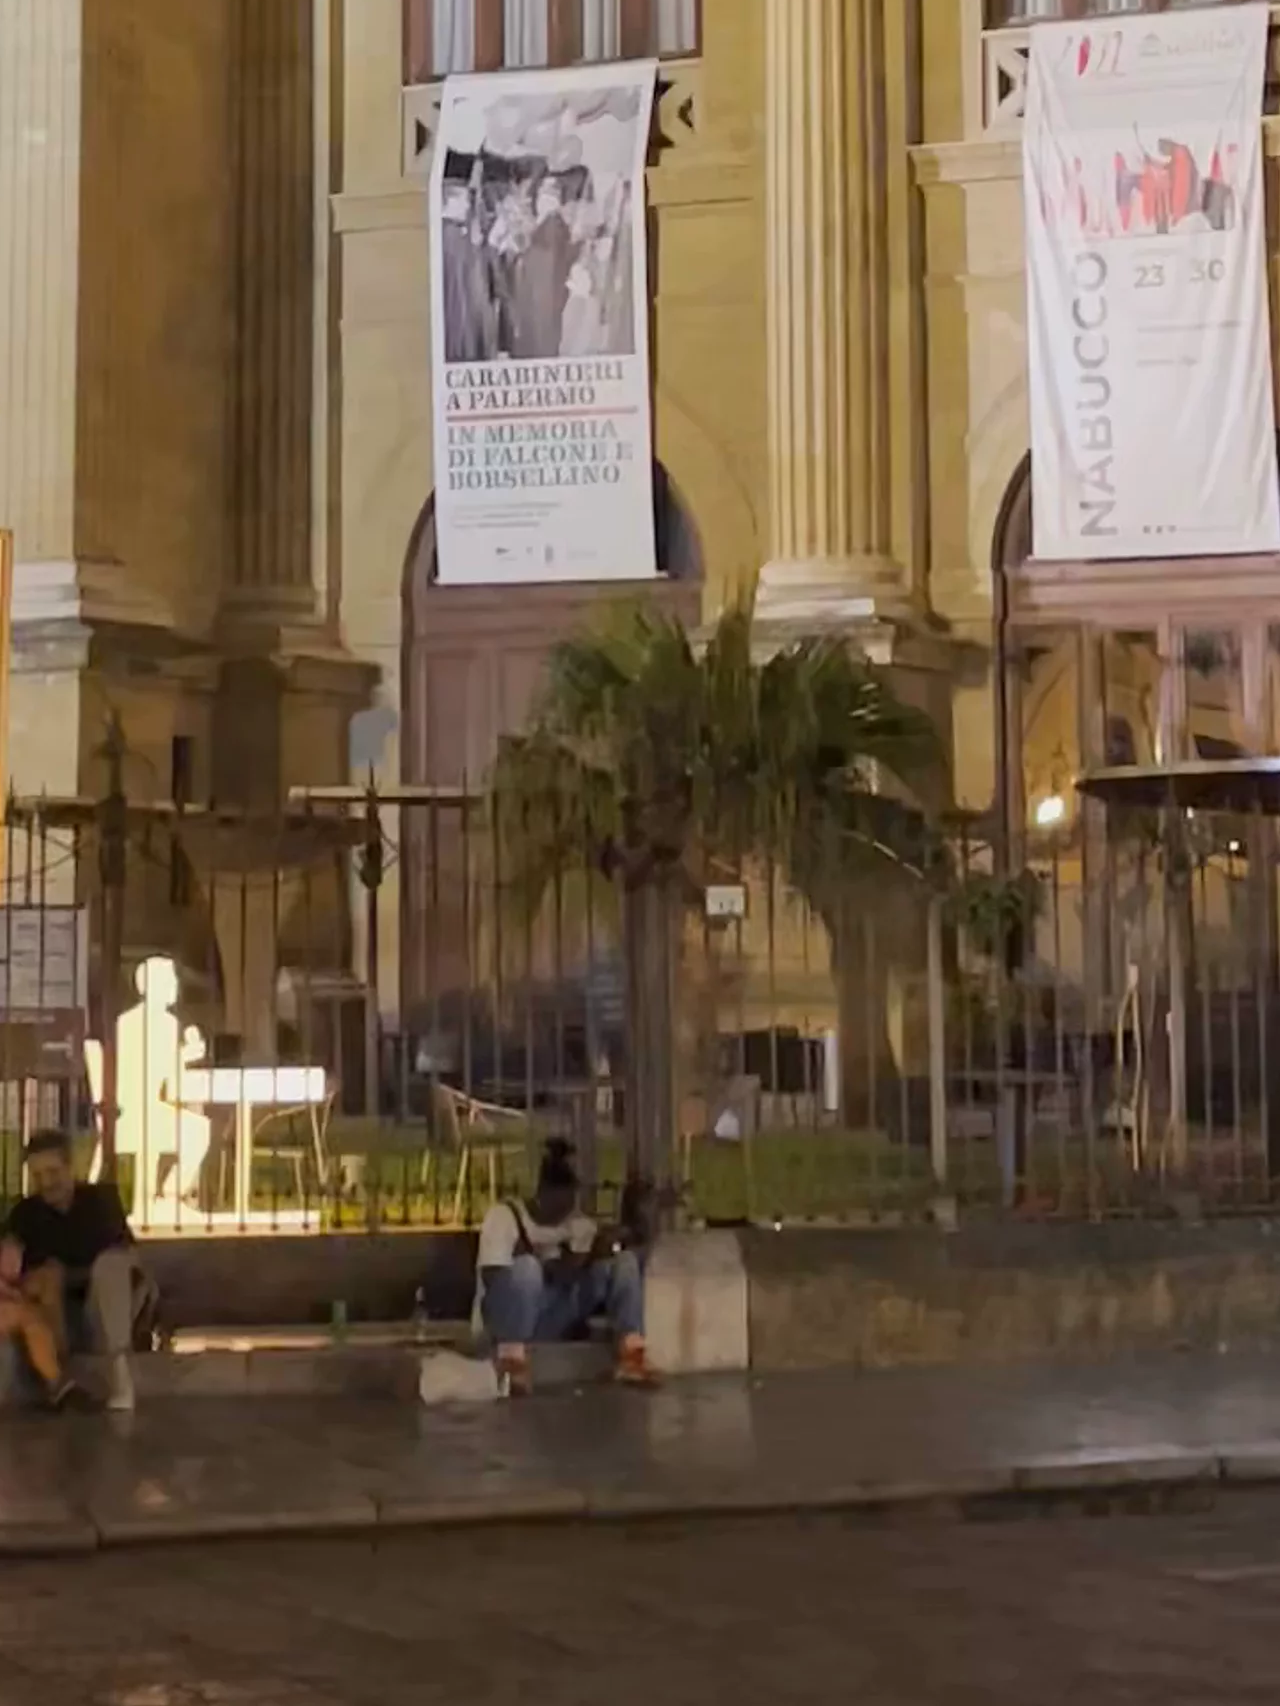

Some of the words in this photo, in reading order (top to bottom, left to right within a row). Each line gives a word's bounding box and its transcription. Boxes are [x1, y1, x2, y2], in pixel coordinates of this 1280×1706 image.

[1133, 263, 1165, 290] 23
[1188, 258, 1225, 283] 30
[445, 361, 624, 388] CARABINIERI
[446, 392, 461, 411] A
[469, 387, 596, 410] PALERMO
[1071, 251, 1118, 537] NABUCCO
[447, 425, 476, 445] IN
[484, 419, 619, 444] MEMORIA
[448, 447, 476, 468] DI
[484, 443, 607, 466] FALCONE
[616, 441, 634, 461] E
[449, 465, 621, 490] BORSELLINO
